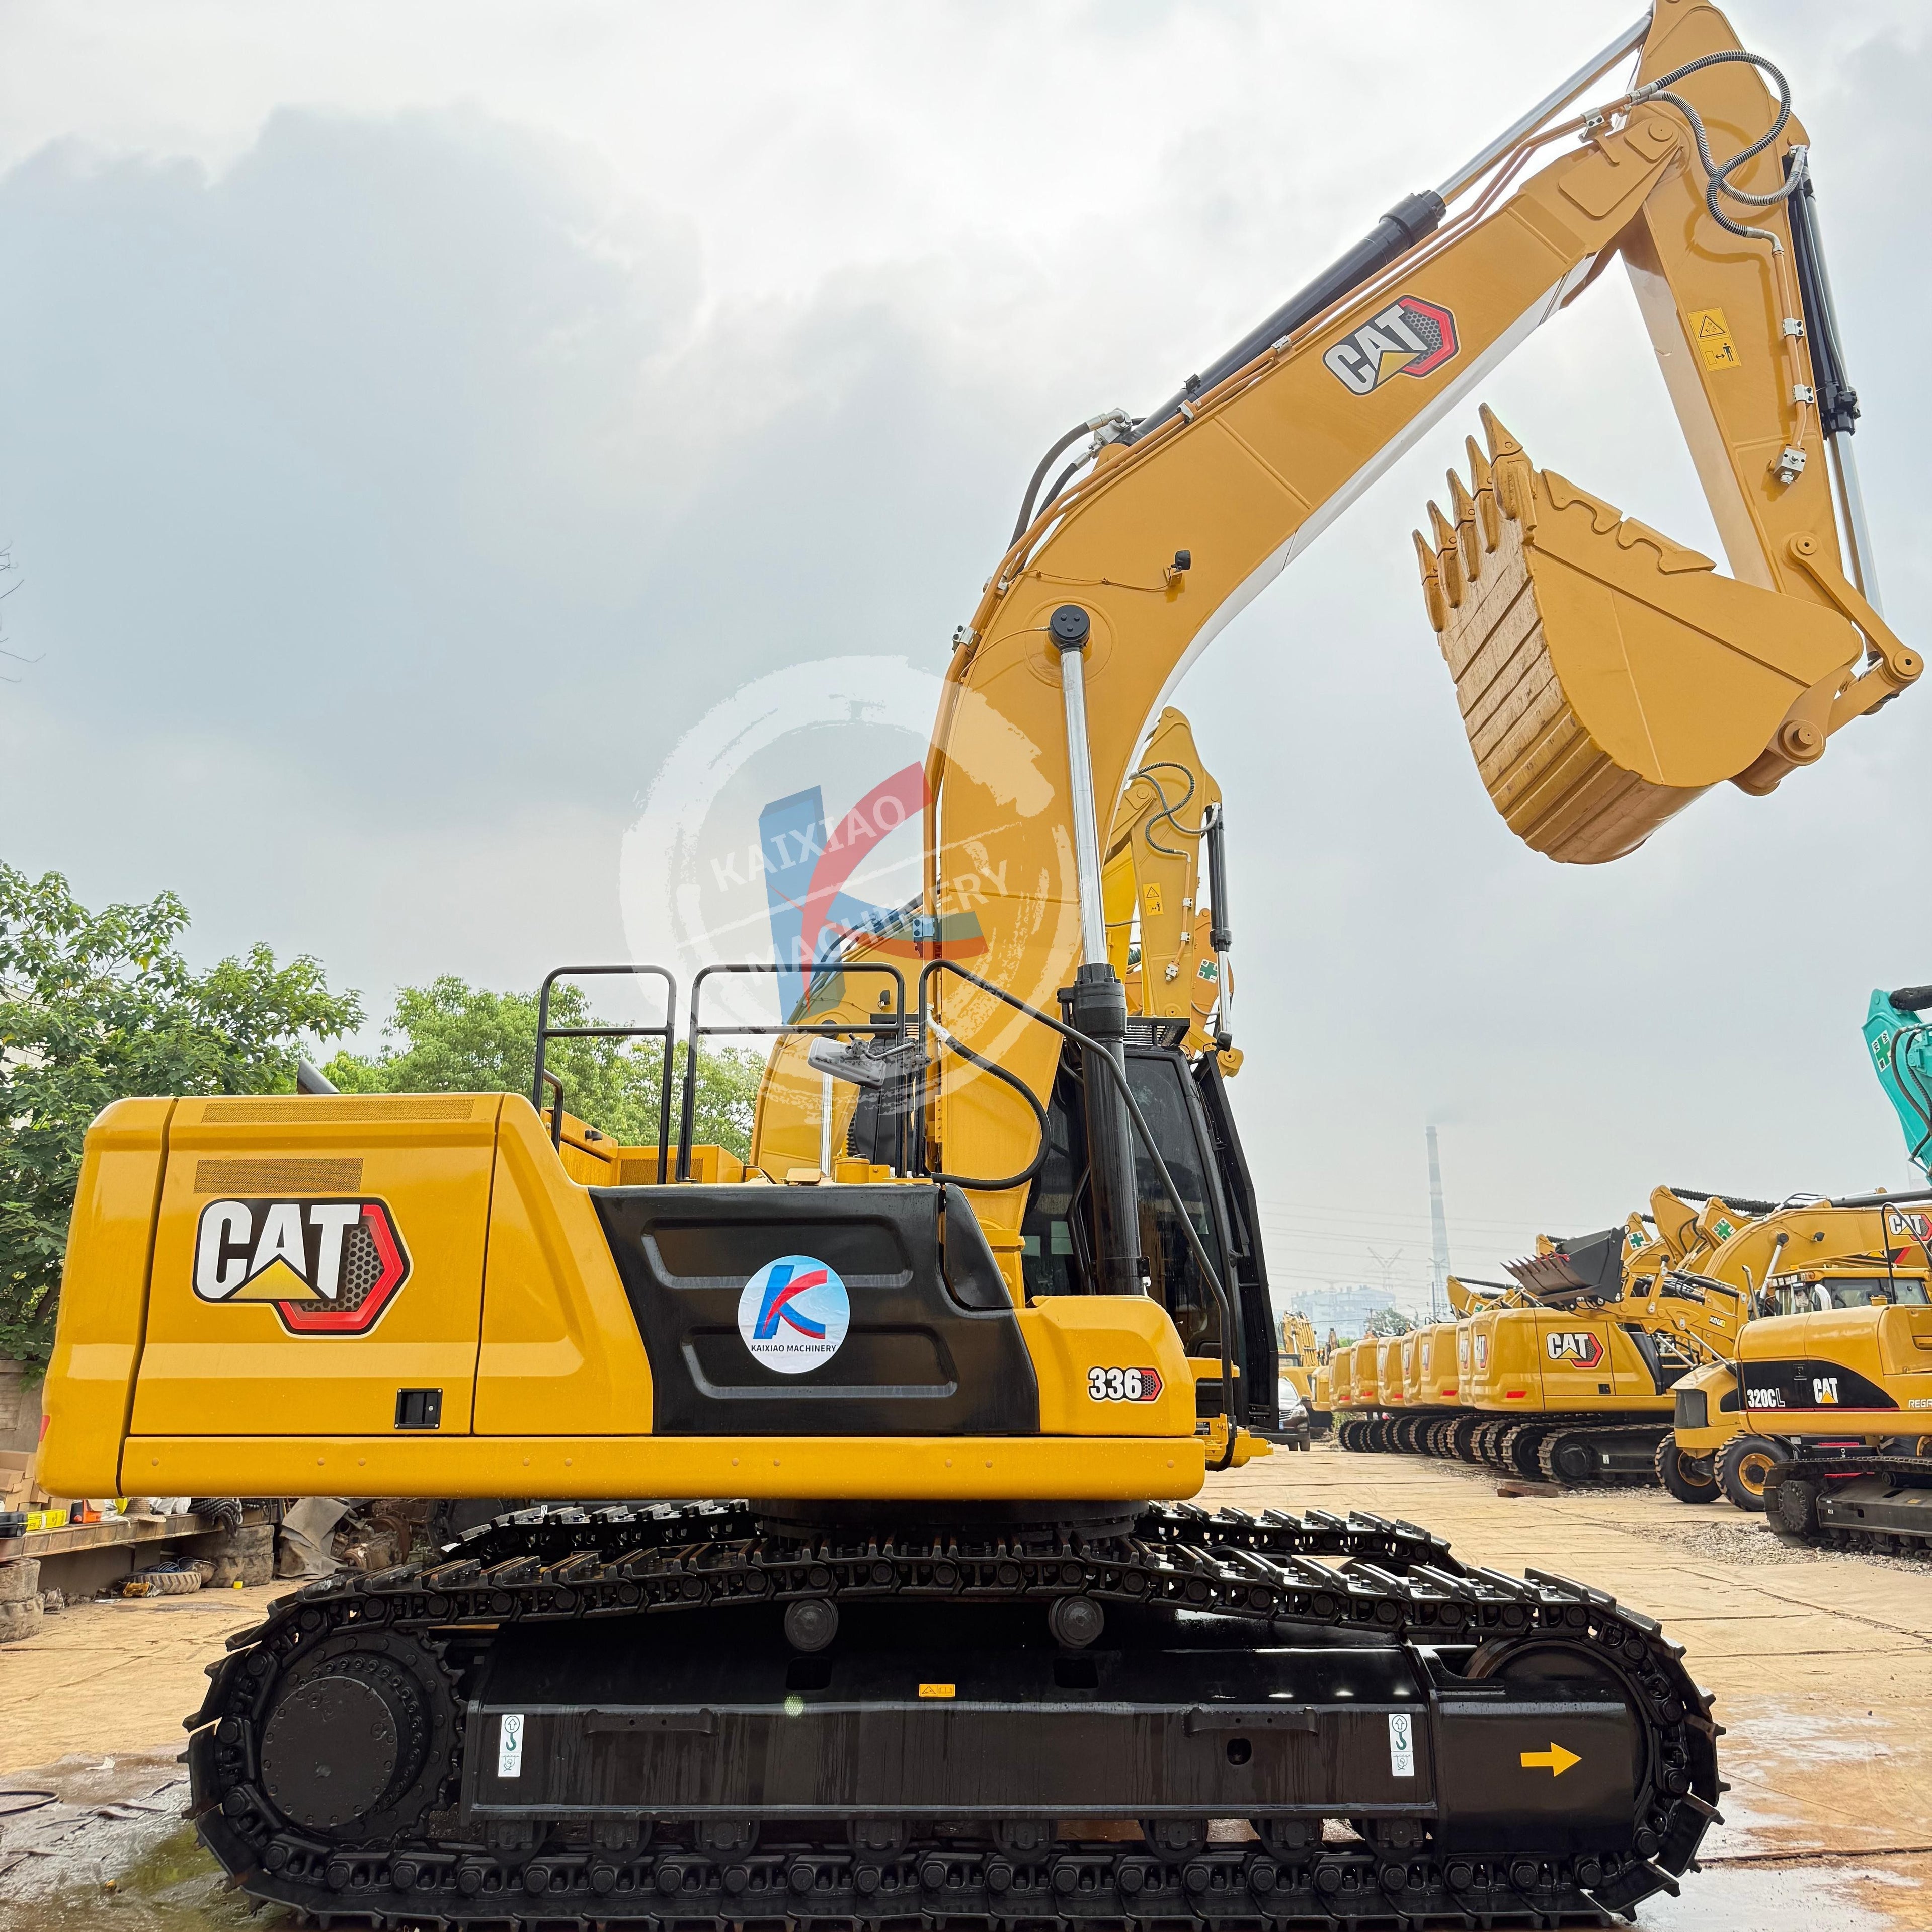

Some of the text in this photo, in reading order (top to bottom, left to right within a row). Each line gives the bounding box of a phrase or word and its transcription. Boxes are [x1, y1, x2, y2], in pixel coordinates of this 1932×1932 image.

[1325, 304, 1428, 393] CAT
[1889, 1214, 1922, 1235] CAT
[197, 1201, 360, 1299] CAT
[1547, 1333, 1588, 1358] CAT
[1089, 1368, 1142, 1399] 336
[1813, 1378, 1838, 1403] CAT
